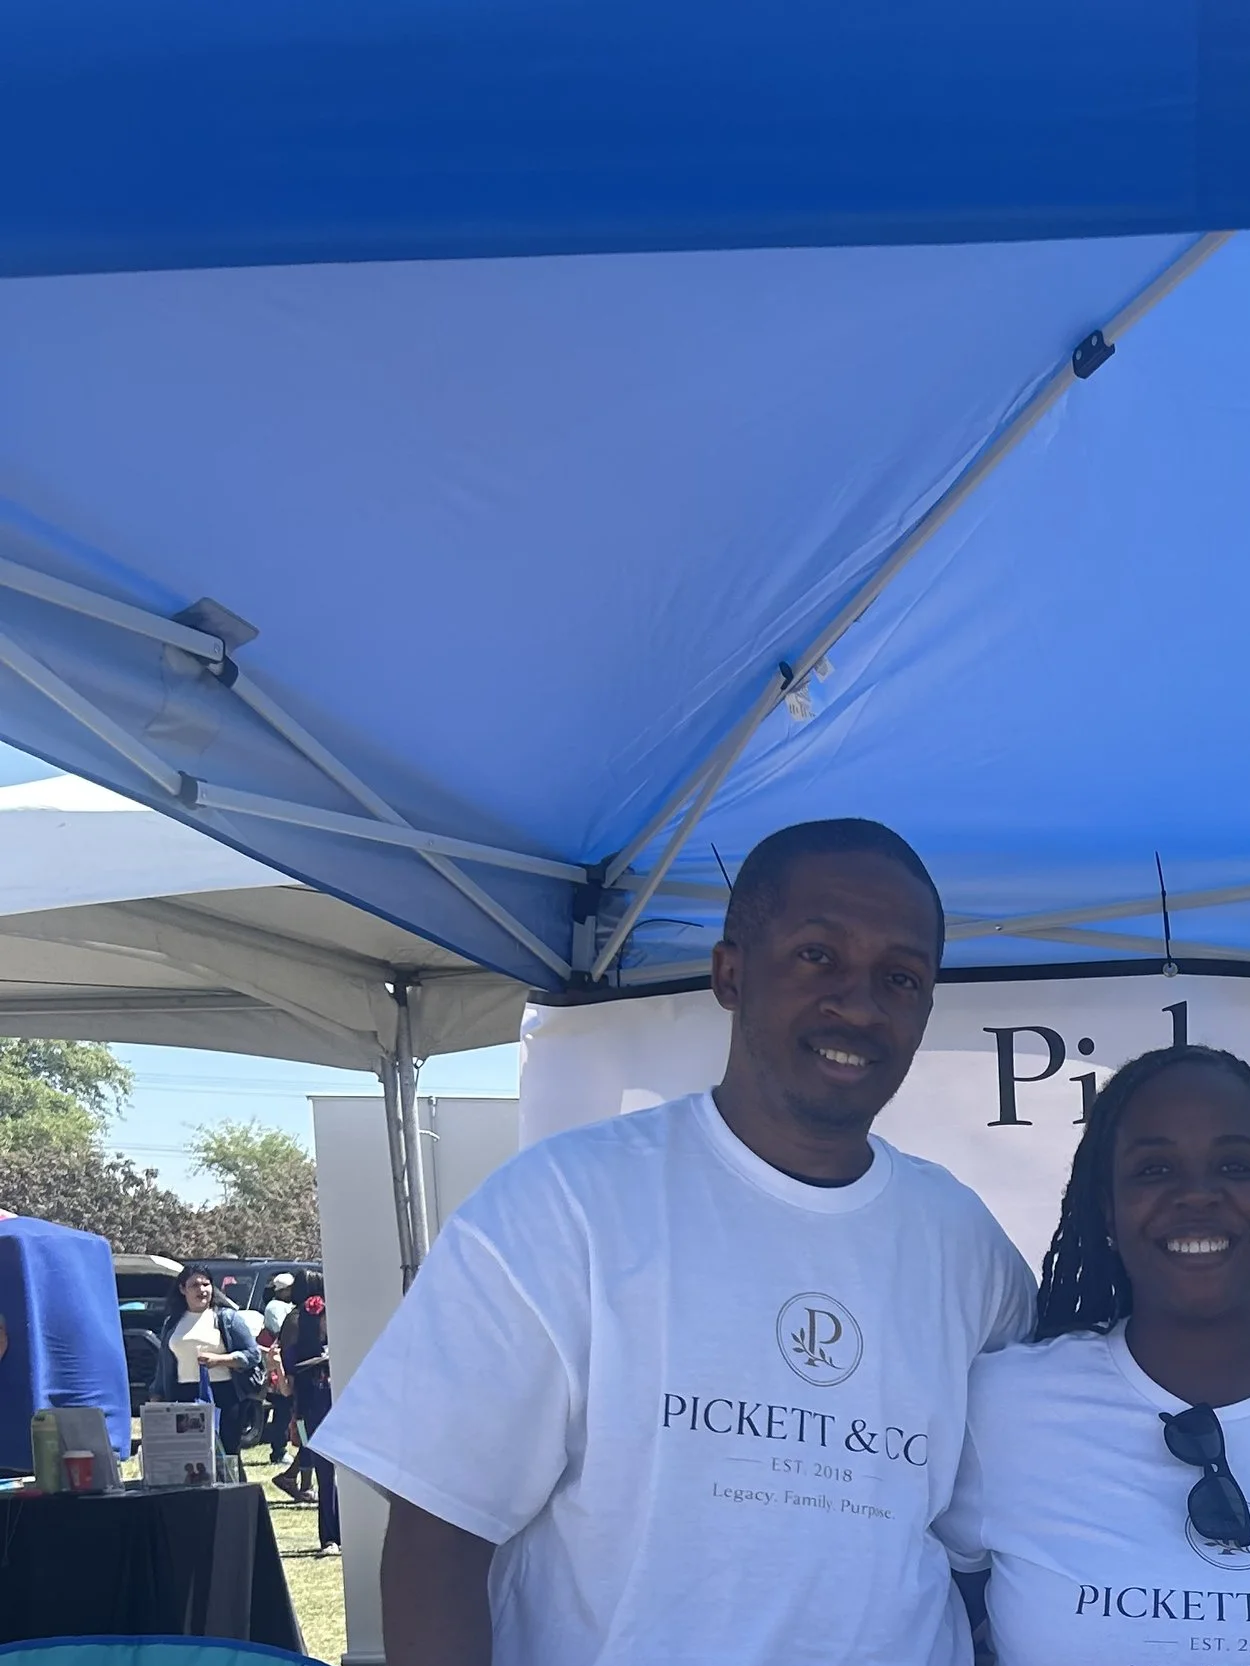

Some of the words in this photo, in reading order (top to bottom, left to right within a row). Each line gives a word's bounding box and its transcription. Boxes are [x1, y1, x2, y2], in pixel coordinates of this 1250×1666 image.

[804, 1308, 843, 1368] P
[662, 1393, 836, 1447] PICKETT
[844, 1419, 880, 1454] &
[814, 1463, 853, 1482] 2018
[713, 1483, 777, 1504] Legacy.
[784, 1490, 837, 1512] Family.
[840, 1499, 896, 1520] Purpose.
[1190, 1637, 1230, 1651] EST.
